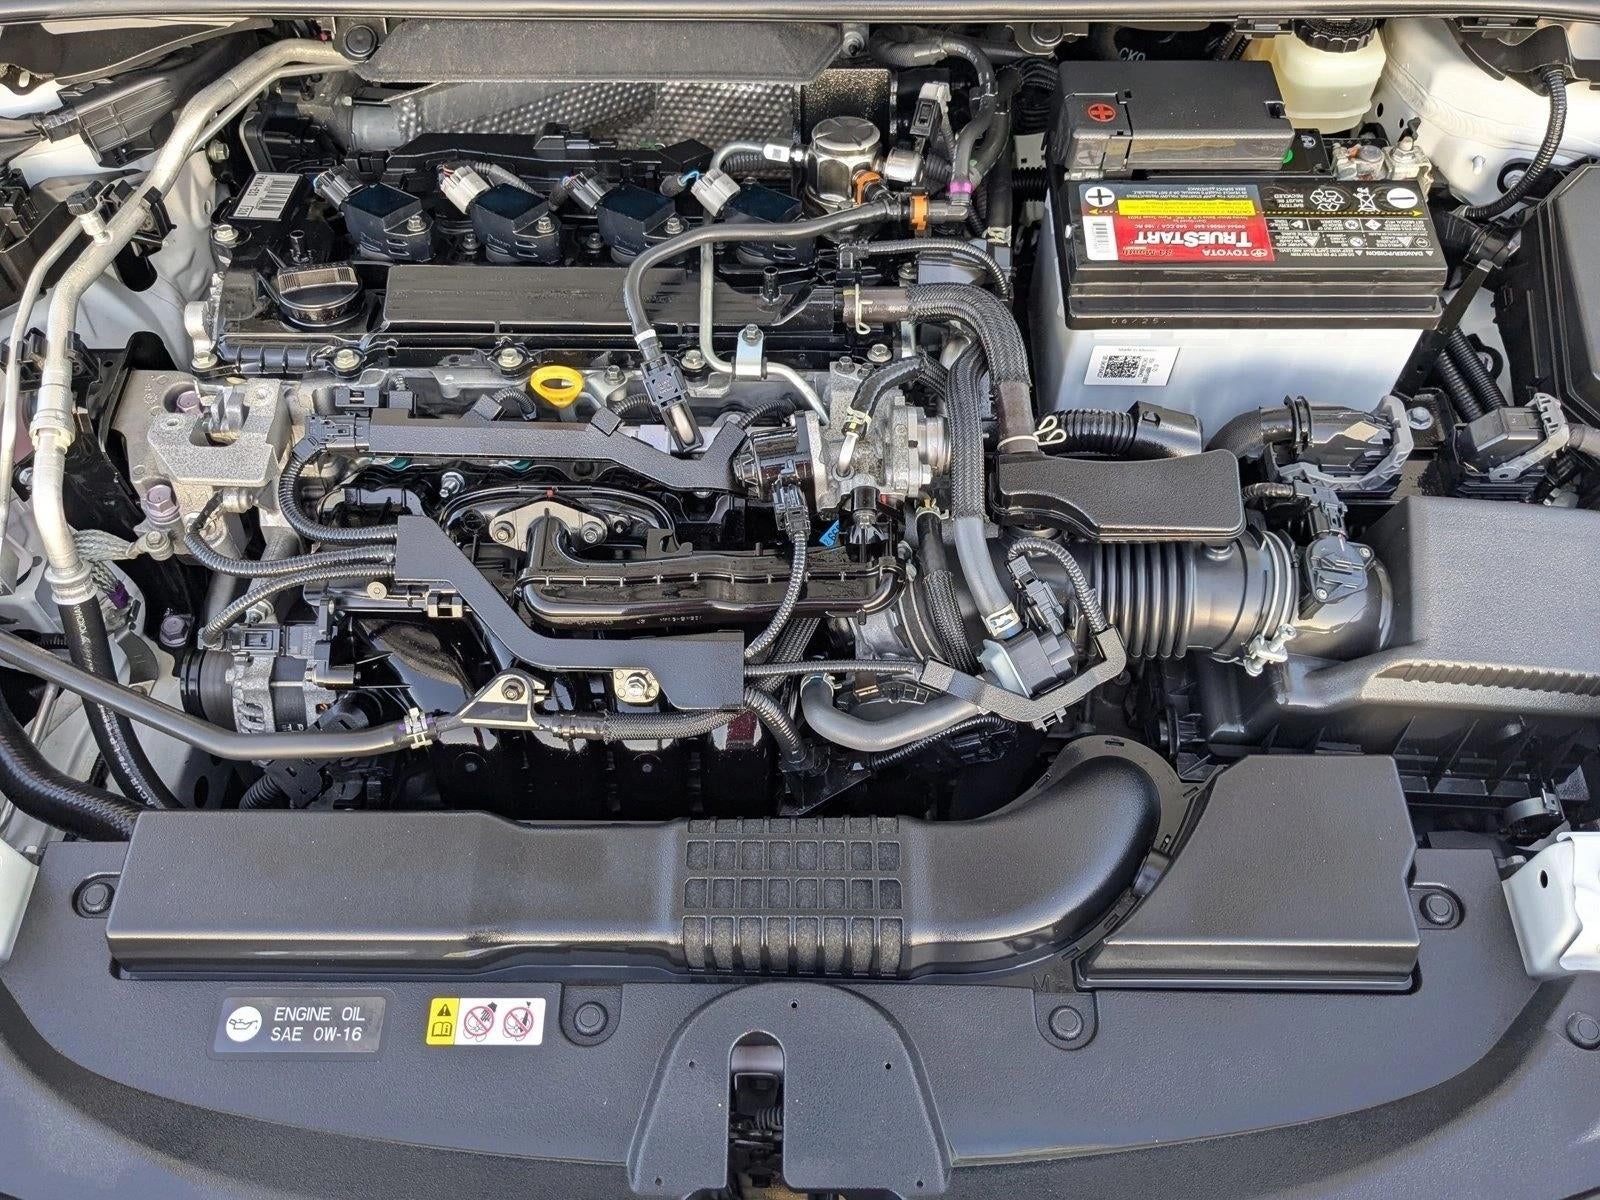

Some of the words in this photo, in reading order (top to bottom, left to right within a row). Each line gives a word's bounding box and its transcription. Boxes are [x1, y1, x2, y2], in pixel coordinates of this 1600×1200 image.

[1201, 249, 1250, 257] TOYOTA
[274, 1006, 332, 1021] ENGINE
[341, 1006, 366, 1021] OIL
[270, 1026, 304, 1041] SAE
[313, 1026, 363, 1041] 0W-16
